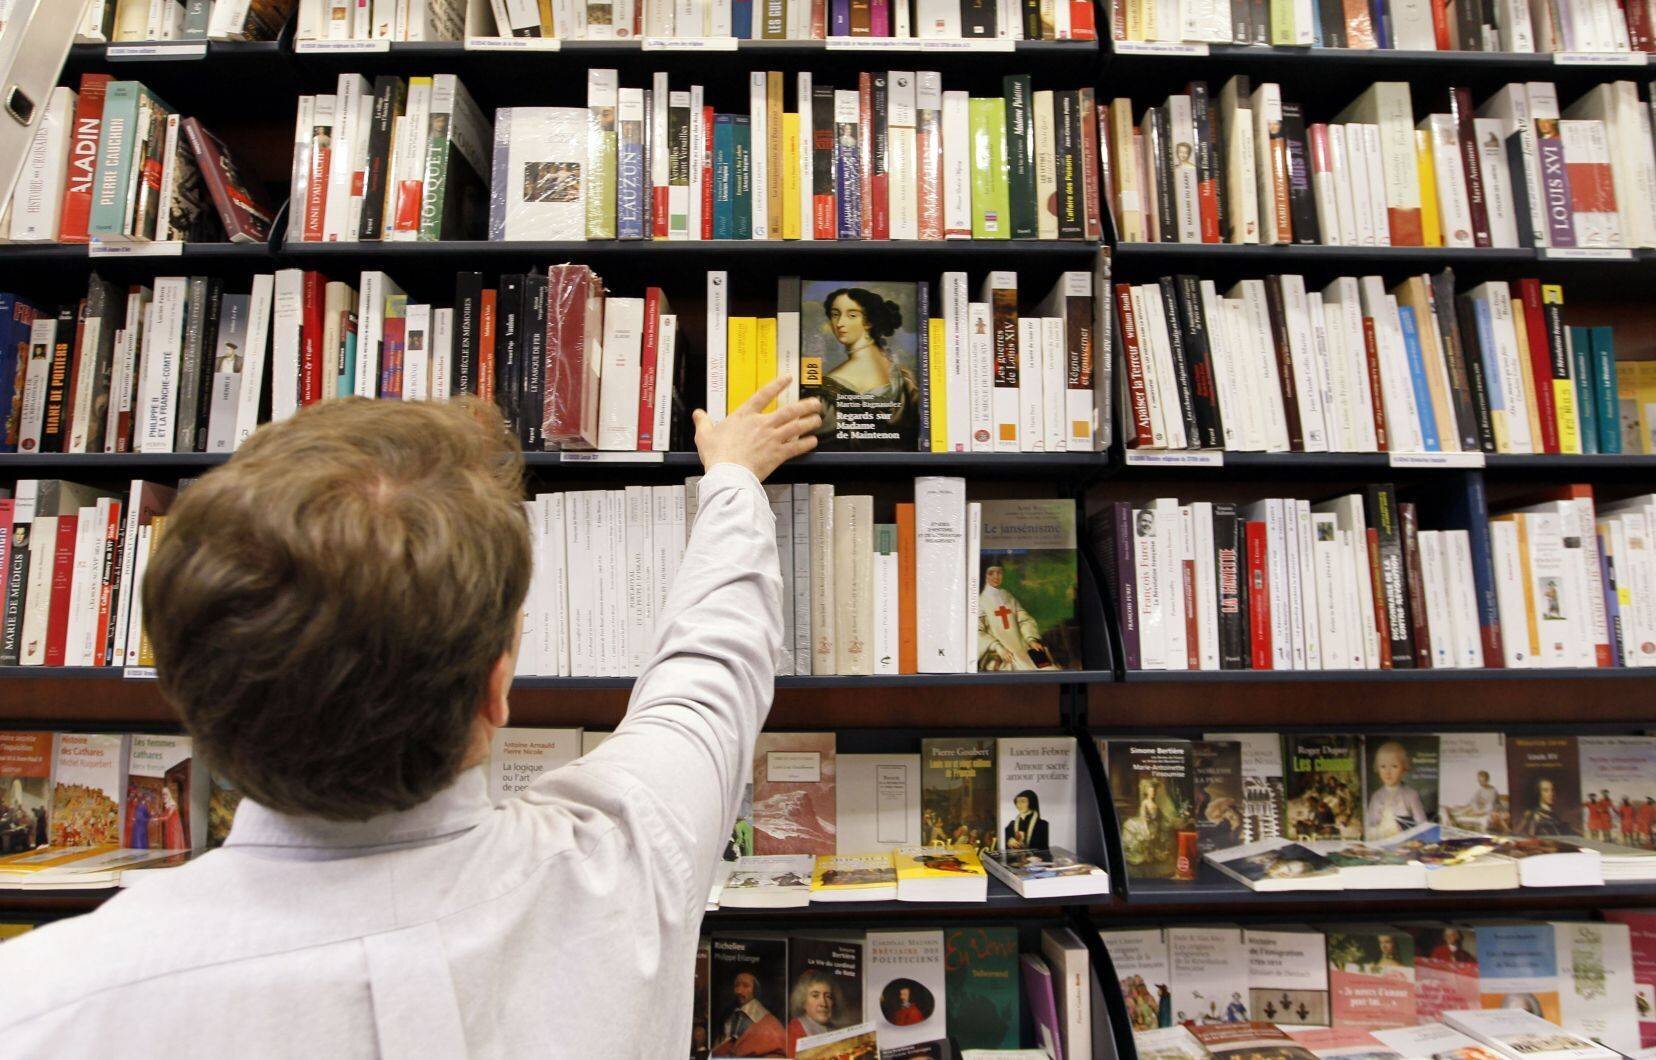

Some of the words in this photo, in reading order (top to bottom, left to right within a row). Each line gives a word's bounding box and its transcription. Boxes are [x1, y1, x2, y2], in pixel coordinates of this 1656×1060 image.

[1062, 154, 1073, 181] Poisons
[1465, 140, 1480, 181] Antoinette
[1544, 146, 1562, 174] XVI
[99, 171, 117, 206] PIERRE
[421, 145, 444, 230] FOUQUET
[616, 150, 638, 221] LAUZUN
[1064, 181, 1073, 194] des
[1471, 180, 1482, 204] Marie
[1065, 195, 1074, 222] L'affaire
[1549, 179, 1569, 230] LOUIS
[309, 207, 323, 232] ANNE
[1121, 292, 1132, 311] Bush
[461, 297, 474, 336] MÉMOIRES
[1124, 312, 1137, 339] William
[532, 333, 541, 344] FER
[1003, 320, 1016, 342] XIV
[463, 337, 472, 348] EN
[532, 344, 541, 354] DE
[995, 330, 1007, 364] guerres
[1080, 327, 1092, 374] gouverner
[1554, 335, 1565, 367] Révolution
[52, 343, 68, 386] POITIERS
[461, 348, 472, 374] SIÈCLE
[1005, 342, 1017, 370] Louis
[1129, 344, 1143, 380] Terreur
[531, 354, 541, 383] MASQUE
[806, 362, 820, 381] DDB
[996, 366, 1006, 384] Les
[1006, 371, 1016, 384] de
[1069, 351, 1080, 385] Régner
[1082, 374, 1090, 386] et
[1132, 379, 1143, 390] la
[52, 388, 62, 401] DE
[46, 404, 60, 434] DIANE
[836, 411, 875, 422] Regards
[875, 412, 893, 421] sur
[1134, 391, 1151, 429] Apaiser
[149, 402, 160, 438] PHILIPPE
[159, 416, 167, 427] LA
[836, 421, 876, 431] Madame
[158, 429, 166, 438] ET
[836, 431, 849, 440] de
[850, 431, 901, 440] Maintenon
[983, 523, 998, 535] Le
[1000, 522, 1061, 536] jansénisme
[1138, 540, 1150, 569] Furet
[1382, 558, 1392, 571] LA
[9, 553, 24, 597] MÉDICIS
[1383, 571, 1393, 583] DE
[1125, 583, 1134, 602] FURET
[1140, 571, 1153, 615] François
[9, 598, 18, 615] DE
[1220, 597, 1239, 614] LA
[1385, 584, 1401, 641] DICTIONNAIRE
[1127, 603, 1136, 631] FRANÇOIS
[5, 616, 17, 650] MARIE
[61, 747, 72, 755] des
[932, 747, 954, 757] Pierre
[1009, 746, 1040, 757] Lucien
[1041, 746, 1071, 757] Febvre
[1130, 746, 1156, 754] Simone
[1156, 746, 1185, 755] Bertière
[1298, 745, 1321, 756] Roger
[503, 763, 512, 771] La
[513, 763, 544, 773] logique
[1014, 762, 1045, 771] Amour
[1132, 763, 1186, 771] Marie-Antoinette
[1293, 756, 1312, 772] Les
[502, 774, 513, 782] ou
[515, 773, 530, 782] l'art
[1005, 773, 1036, 782] amour
[1036, 772, 1069, 784] profane
[502, 783, 512, 792] de
[714, 941, 746, 951] Richelieu
[872, 956, 940, 965] POLITICIENS
